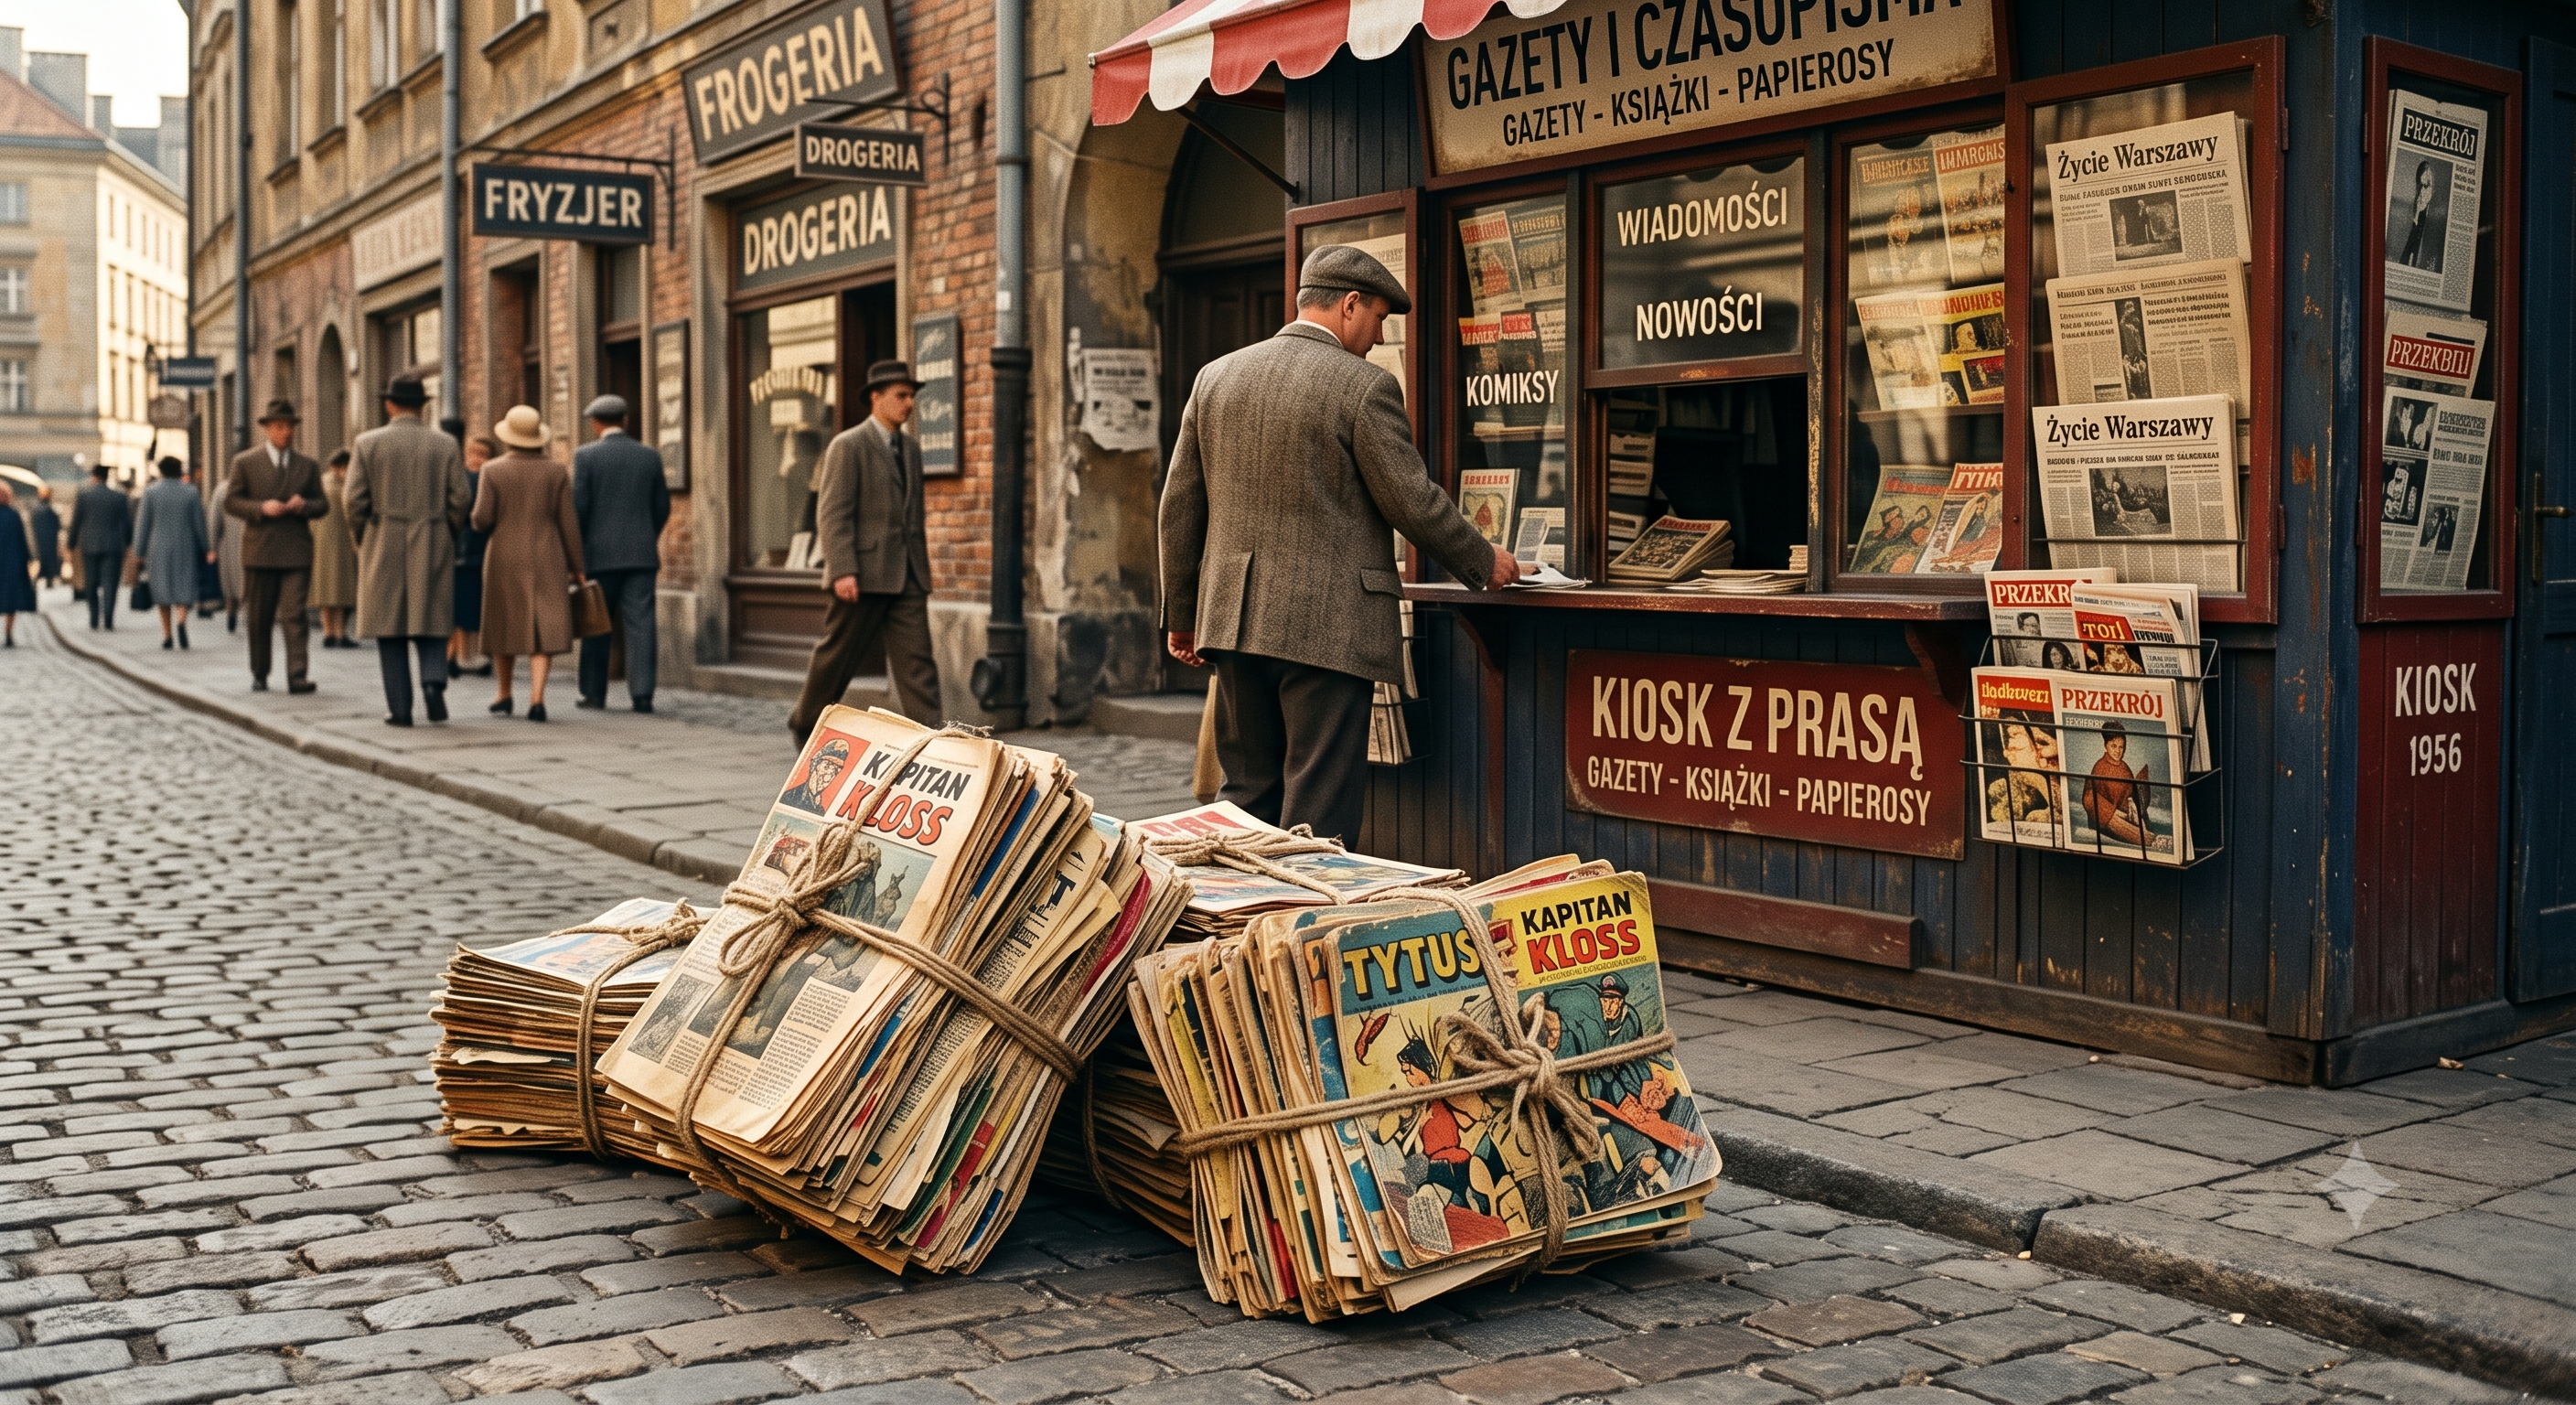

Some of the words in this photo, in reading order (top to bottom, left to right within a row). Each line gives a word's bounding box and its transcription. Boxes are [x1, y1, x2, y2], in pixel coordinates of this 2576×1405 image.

[693, 5, 885, 143] FROGERIA
[1447, 16, 1593, 110] GAZETY
[1607, 10, 1621, 78] I
[1503, 99, 1586, 146] GAZETY
[1594, 112, 1604, 120] -
[1611, 73, 1711, 126] KSIĄŻKI
[1718, 88, 1728, 96] -
[1738, 38, 1894, 104] PAPIEROSY
[805, 134, 920, 173] DROGERIA
[2058, 149, 2109, 182] Życie
[2113, 135, 2218, 170] Warszawy
[484, 177, 643, 229] FRYZJER
[744, 186, 892, 275] DROGERIA
[1617, 180, 1787, 246] WIADOMOŚCI
[1637, 285, 1762, 342] NOWOŚCI
[1465, 370, 1559, 407] KOMIKSY
[2046, 413, 2100, 447] Życie
[2104, 414, 2214, 441] Warszawy
[2395, 662, 2477, 717] KIOSK
[1593, 675, 1713, 748] KIOSK
[1727, 685, 1753, 751] Z
[1768, 687, 1923, 781] PRASĄ
[2410, 732, 2462, 777] 1956
[1587, 755, 1663, 795] GAZETY
[1686, 763, 1771, 811] KSIĄŻKI
[1797, 777, 1931, 827] PAPIEROSY
[1520, 890, 1632, 936] KAPITAN
[1342, 928, 1483, 998] TYTUS
[1526, 918, 1641, 975] KLOSS
